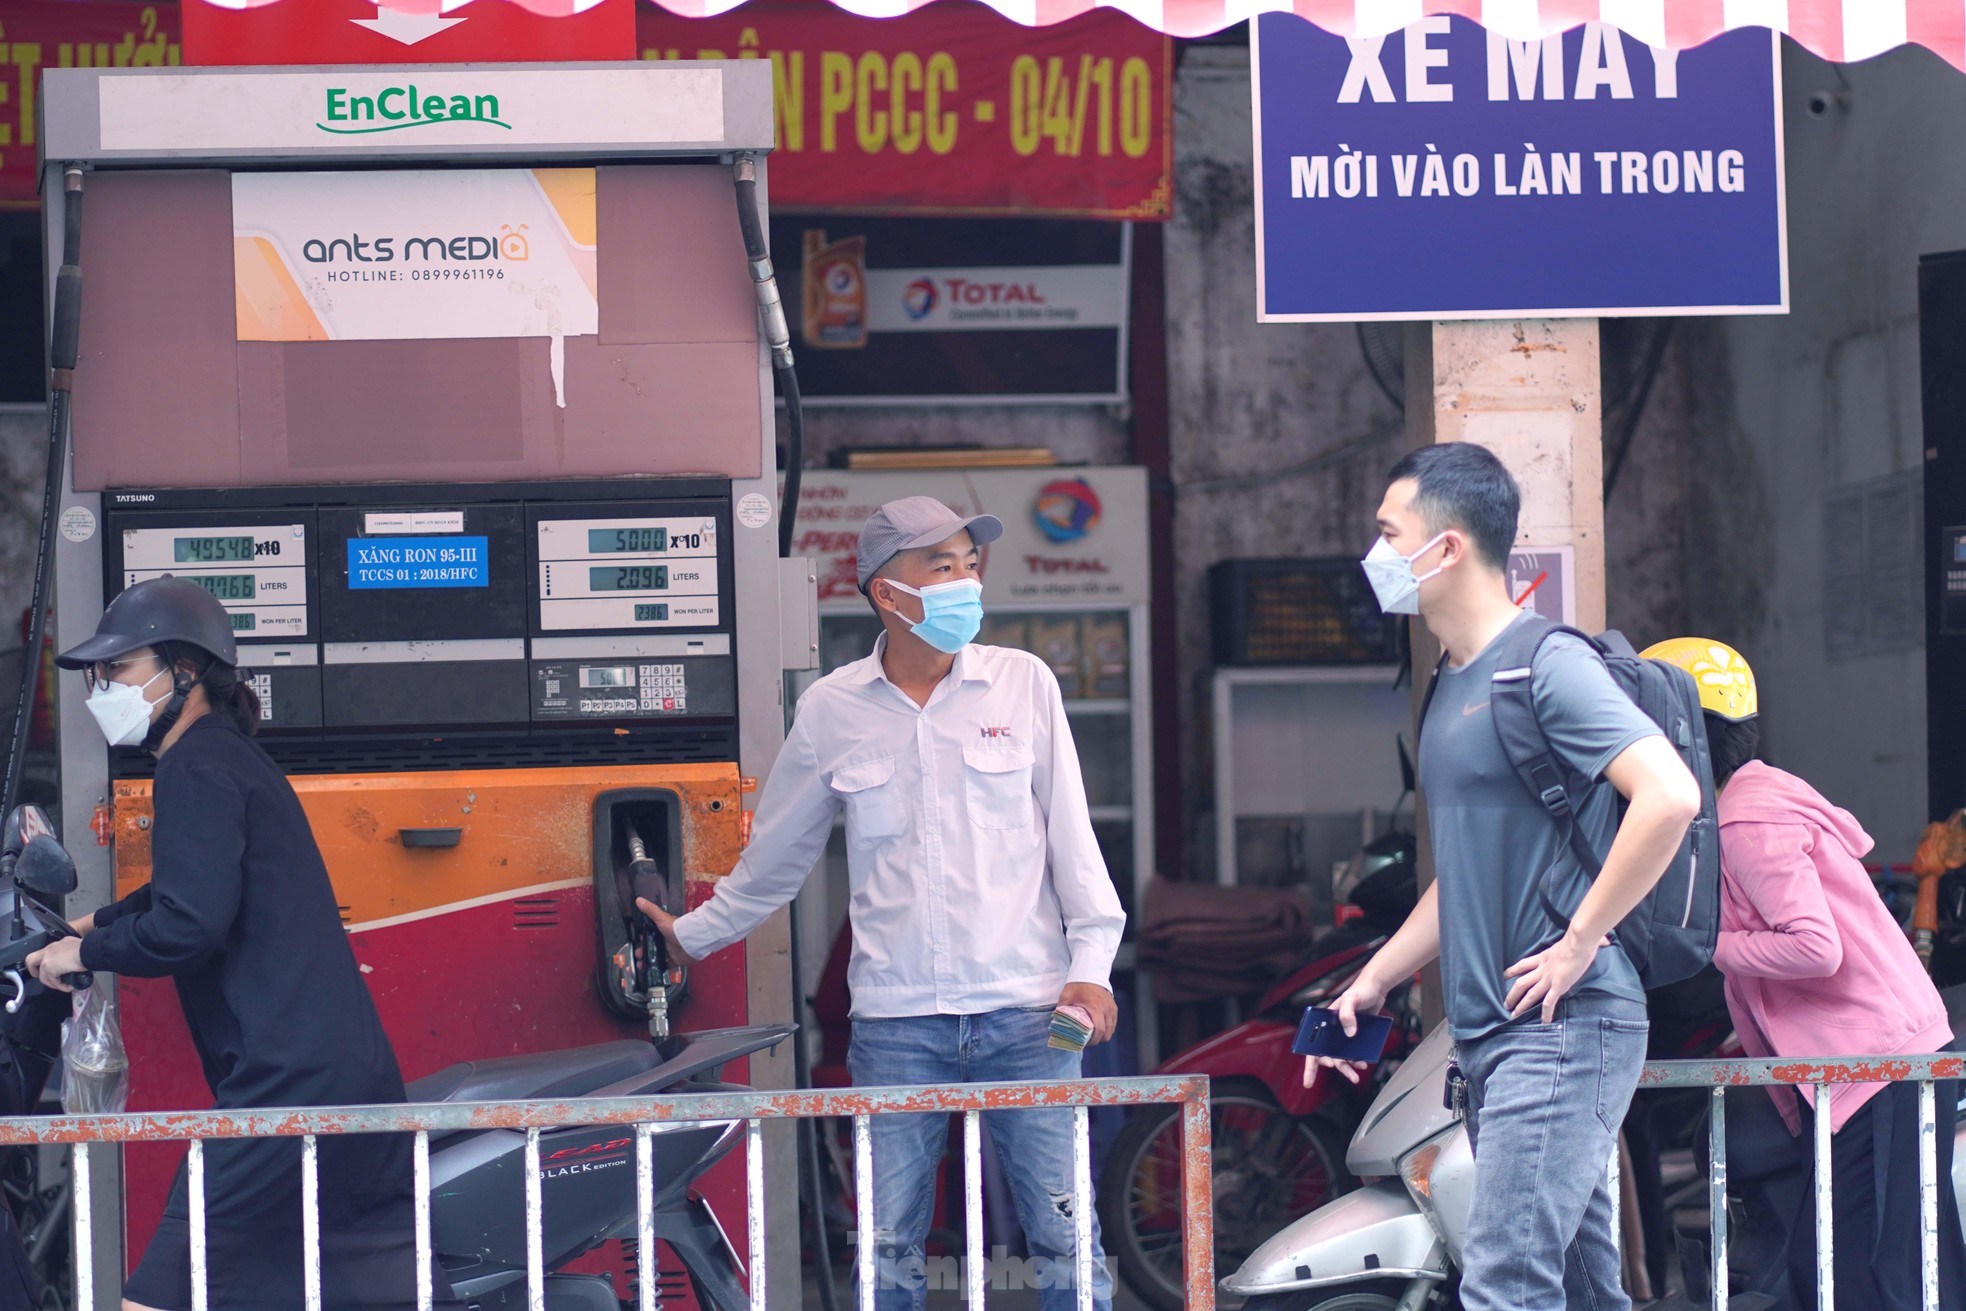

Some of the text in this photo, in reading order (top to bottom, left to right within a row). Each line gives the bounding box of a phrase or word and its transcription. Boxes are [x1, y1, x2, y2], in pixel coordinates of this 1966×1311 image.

[1337, 16, 1453, 103] XE
[327, 85, 499, 120] EnClean
[821, 51, 958, 154] PCCC
[1010, 54, 1152, 158] 04/10
[1290, 143, 1745, 198] MỜI VÀO LÀN TRONG
[303, 233, 394, 262] ants
[328, 268, 504, 282] HOTLINE: 0899961196
[945, 278, 1045, 303] TOTAL
[116, 494, 155, 502] TATSUNO
[616, 529, 664, 551] 5000
[358, 546, 477, 564] XĂNG RON 95-III
[359, 569, 394, 581] TCCS
[396, 569, 410, 580] 01
[420, 567, 478, 580] 2018/HFC
[617, 568, 665, 589] 2.096
[672, 573, 699, 581] LITERS
[260, 582, 288, 590] LITERS
[638, 606, 663, 619] 2386
[980, 727, 1010, 738] HFC
[593, 1160, 627, 1170] EDITION
